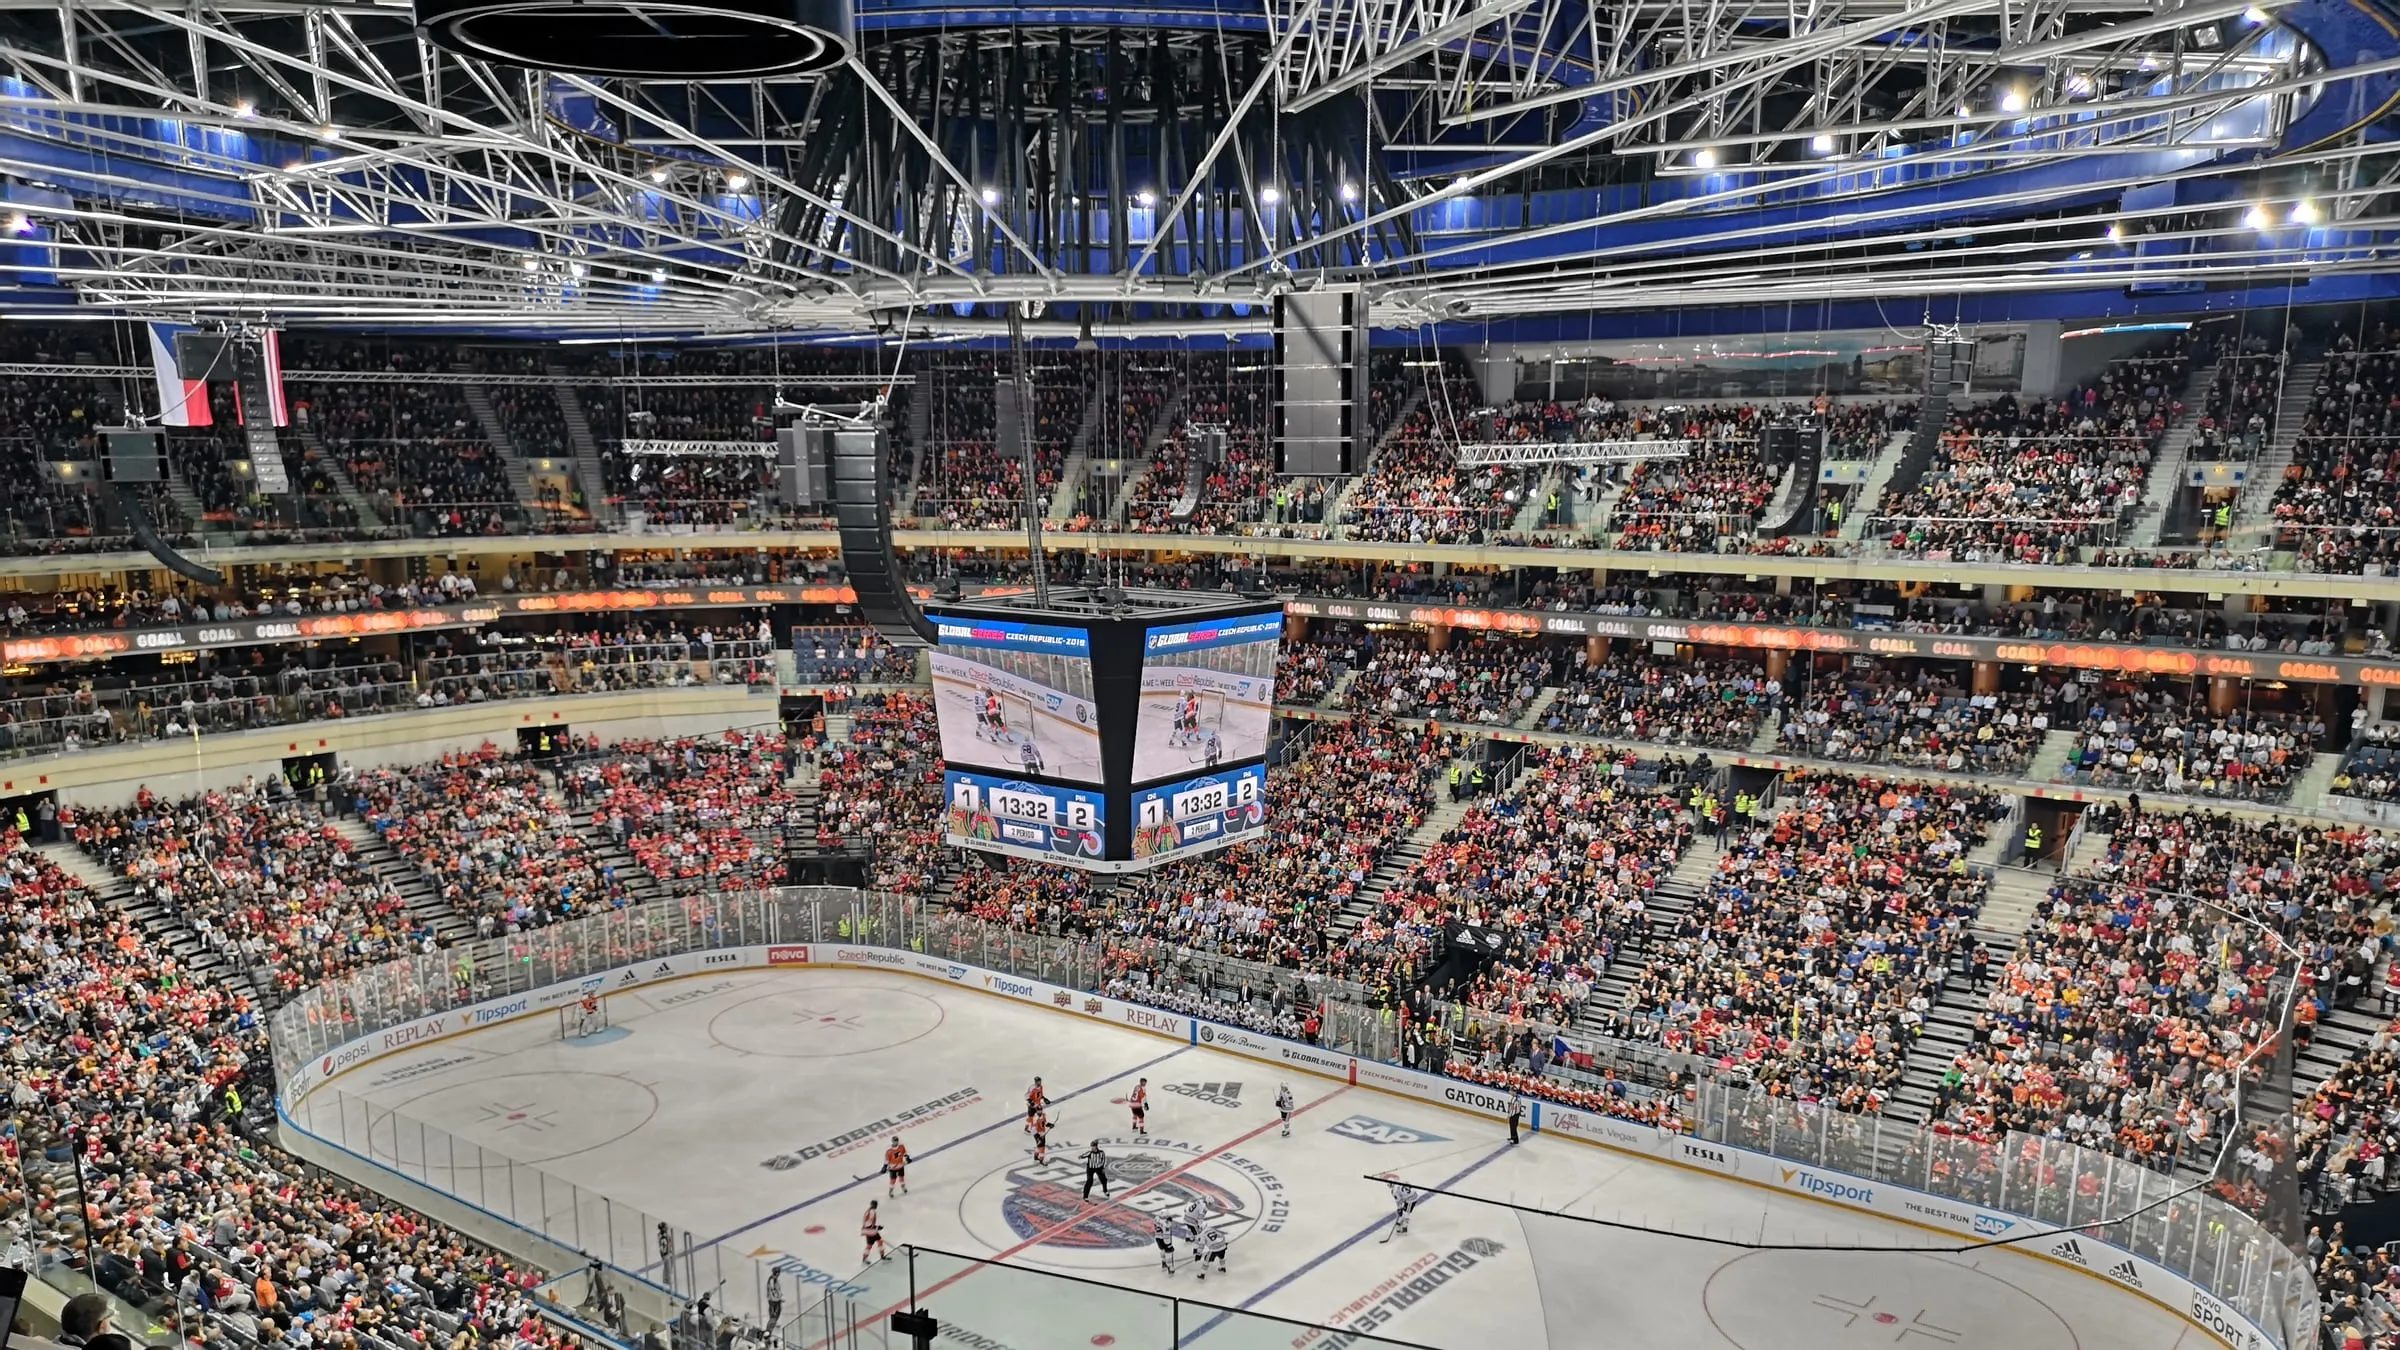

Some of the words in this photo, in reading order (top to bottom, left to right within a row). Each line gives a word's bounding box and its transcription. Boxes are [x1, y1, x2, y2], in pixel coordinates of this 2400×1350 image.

[755, 590, 785, 600] GOAL
[1006, 632, 1028, 641] CZECH
[1218, 627, 1236, 637] CZECH
[952, 669, 967, 678] WEEK
[962, 789, 970, 807] 1
[1243, 783, 1252, 800] 2
[999, 796, 1048, 819] 13:32
[1181, 791, 1222, 815] 13:32
[1076, 807, 1087, 826] 2
[1148, 806, 1155, 823] 1
[1016, 829, 1035, 839] PERIOD
[1195, 823, 1211, 834] PERIOD
[704, 954, 738, 964] TESLA
[771, 950, 805, 962] nova
[837, 949, 905, 965] CzechRepublic
[928, 963, 938, 971] BEST
[949, 966, 964, 979] SAP
[552, 991, 566, 999] BEST
[661, 981, 734, 1005] REPLAY
[994, 977, 1033, 997] Tipsport
[475, 999, 527, 1023] Tipsport
[1127, 1008, 1178, 1033] REPLAY
[383, 1018, 446, 1050] REPLAY
[337, 1042, 371, 1069] pepsi
[1360, 1069, 1379, 1078] CZECH
[1161, 1082, 1243, 1109] adidas
[1335, 1118, 1421, 1144] SAP
[1586, 1123, 1603, 1134] Las
[1607, 1128, 1637, 1142] Vegas
[826, 1137, 875, 1160] CZECH
[1683, 1144, 1724, 1163] TESLA
[1097, 1136, 1203, 1154] GLOBAL
[1217, 1152, 1284, 1192] SERIES
[1261, 1200, 1290, 1233] 2019
[1799, 1172, 1873, 1203] Tipsport
[1905, 1202, 1922, 1213] THE
[1925, 1207, 1948, 1218] BEST
[1950, 1213, 1970, 1224] RUN
[1974, 1216, 2006, 1235] SAP
[2051, 1247, 2087, 1266] adidas
[766, 1254, 871, 1298] Tipsport
[1398, 1252, 1439, 1283] CZECH
[2108, 1267, 2143, 1289] adidas
[2195, 1291, 2222, 1314] nova
[2192, 1303, 2243, 1348] SPORT
